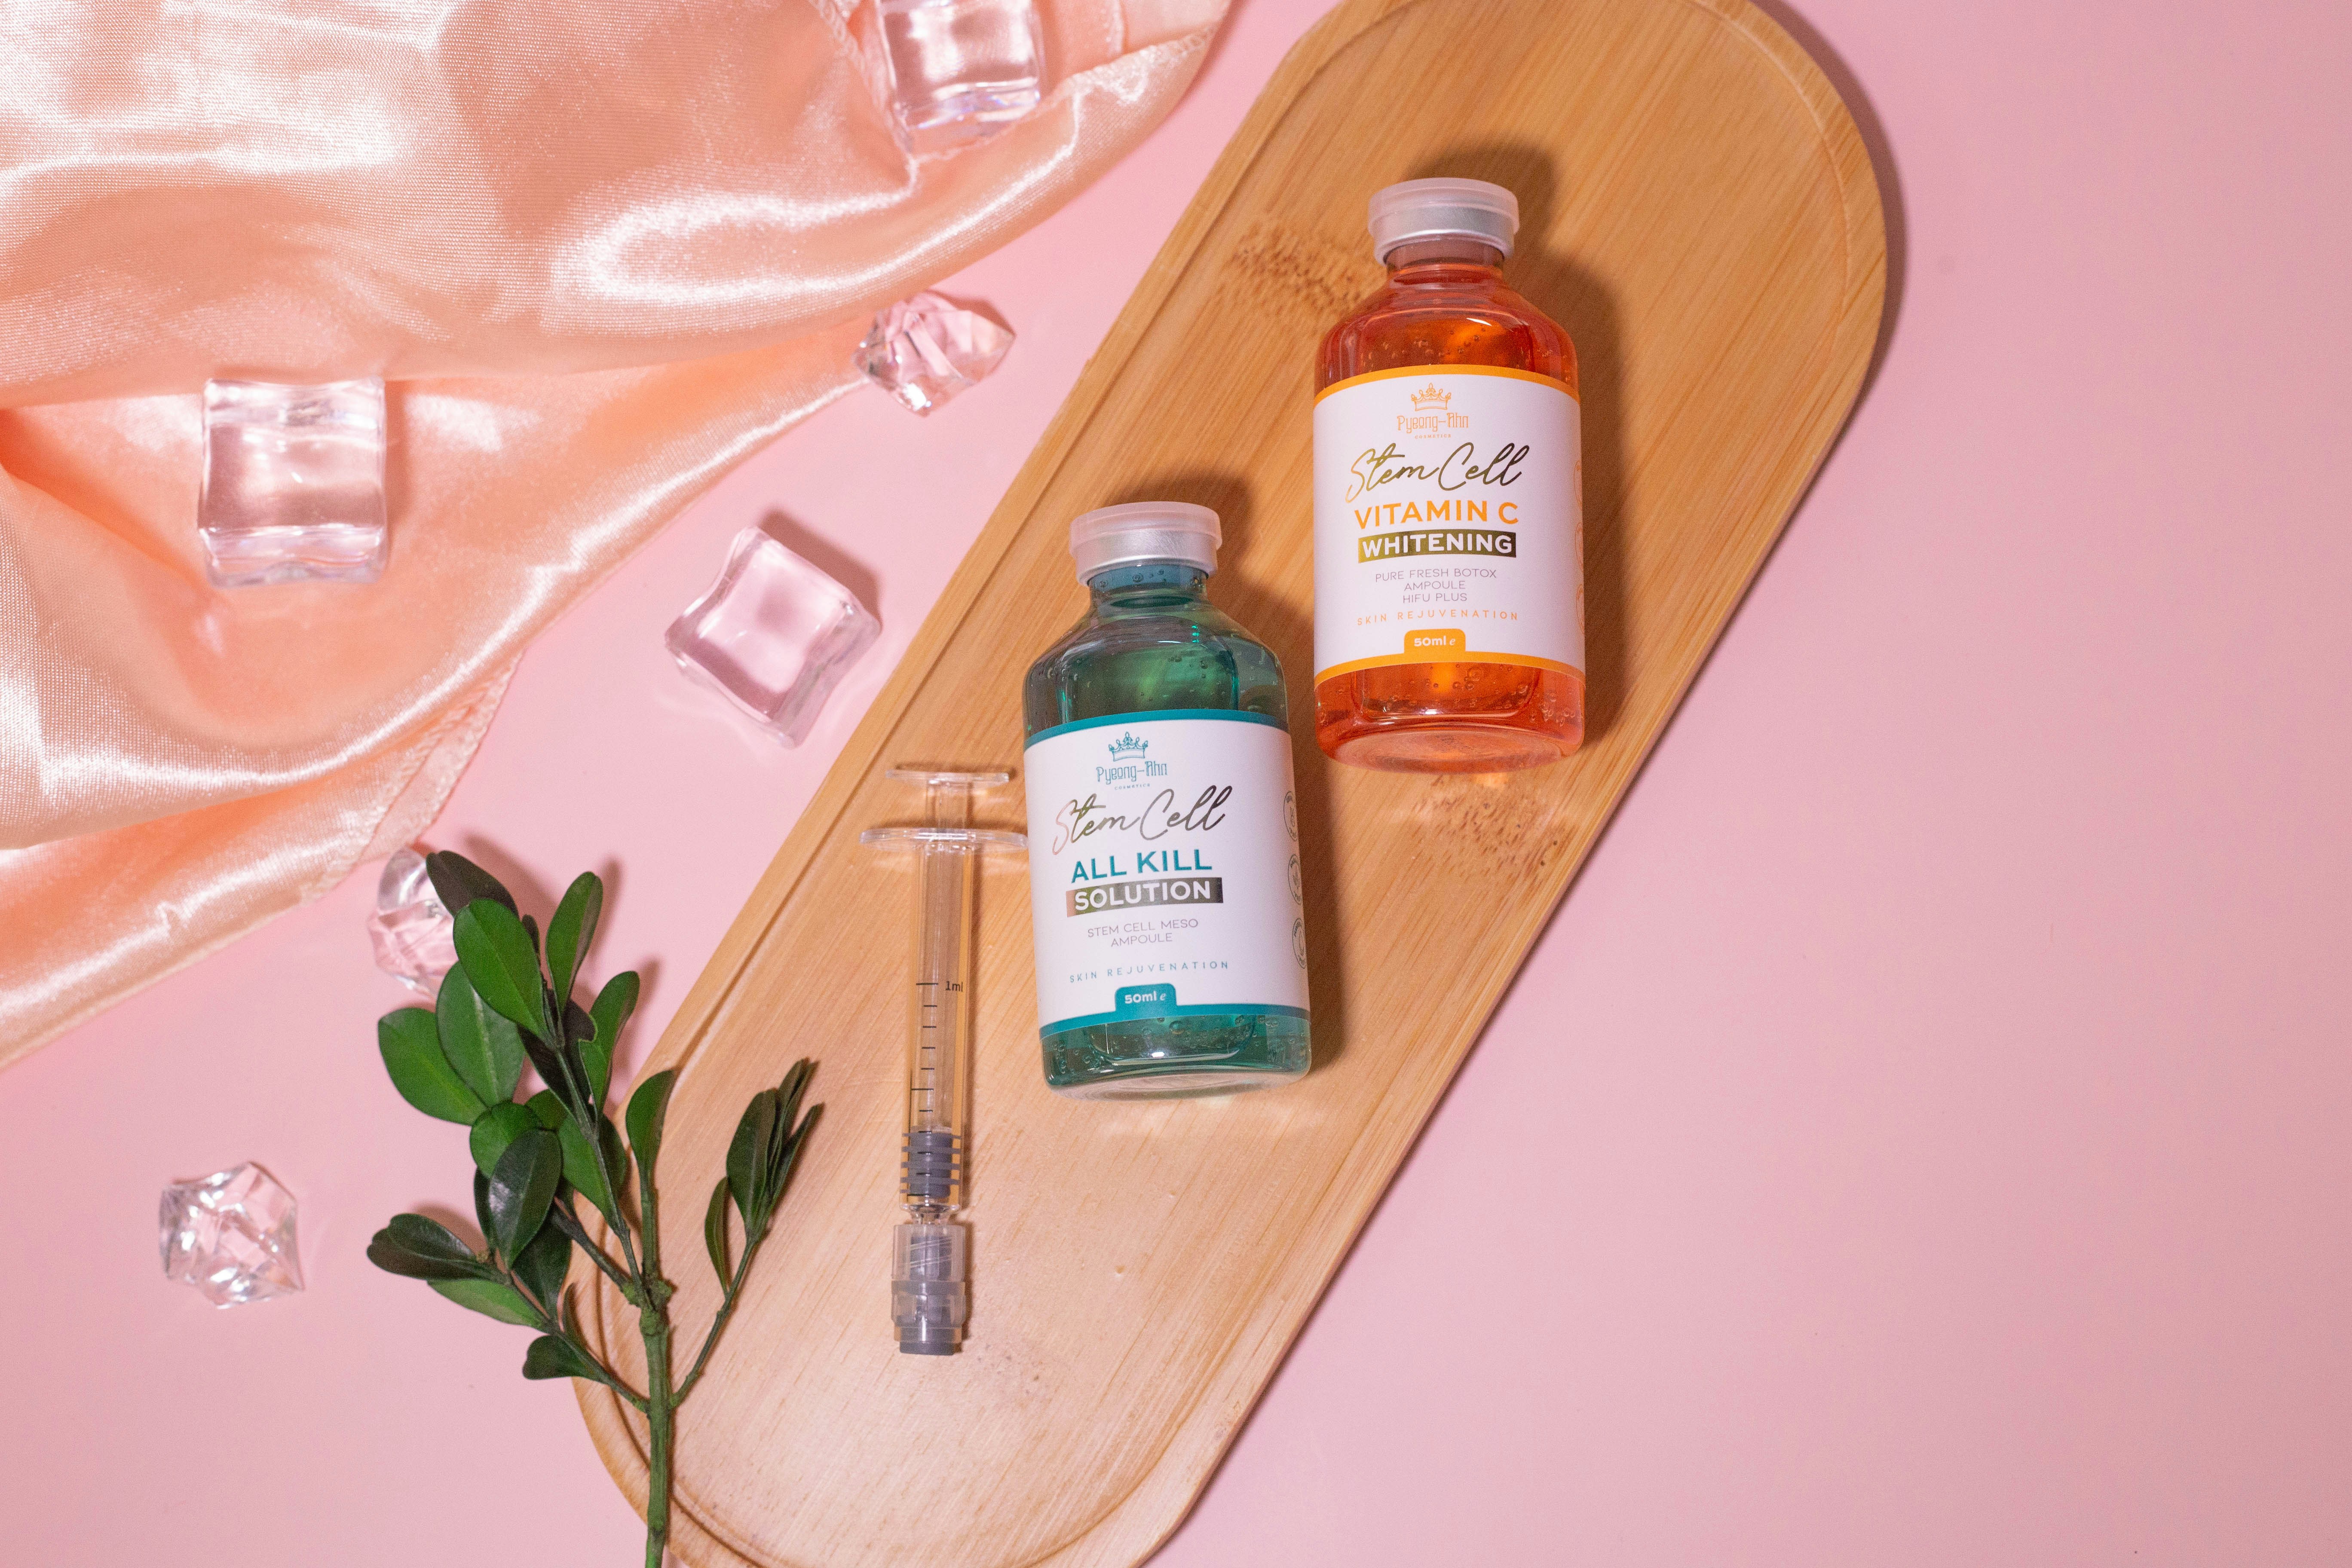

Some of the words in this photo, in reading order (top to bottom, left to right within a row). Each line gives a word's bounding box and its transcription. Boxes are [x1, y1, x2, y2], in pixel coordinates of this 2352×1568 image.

[1396, 413, 1469, 434] Pyeong-Ahn
[1345, 443, 1440, 503] Stem
[1438, 442, 1530, 491] Cell
[1354, 500, 1487, 529] VITAMIN
[1498, 502, 1519, 524] C
[1362, 533, 1512, 558] WHITENING
[1376, 571, 1404, 582] PURE
[1410, 568, 1448, 579] FRESH
[1454, 568, 1497, 578] BOTOX
[1404, 581, 1465, 591] AMPOULE
[1403, 594, 1430, 603] HIFU
[1436, 593, 1467, 601] PLUS
[1357, 613, 1387, 625] SKIN
[1397, 609, 1518, 620] REJUVENATION
[1414, 636, 1446, 646] 50ml
[1096, 761, 1167, 785] Pyeong-Ahn
[1052, 793, 1141, 855] Stem
[1139, 785, 1232, 840] Cell
[1071, 855, 1127, 884] ALL
[1136, 849, 1212, 873] KILL
[1075, 881, 1210, 911] SOLUTION
[1087, 925, 1118, 937] STEM
[1124, 922, 1155, 932] CELL
[1161, 919, 1198, 929] MESO
[1111, 933, 1173, 947] AMPOULE
[1070, 971, 1097, 983] SKIN
[1108, 961, 1228, 977] REJUVENATION
[946, 981, 963, 992] 1ml
[1124, 990, 1157, 1004] 50ml
